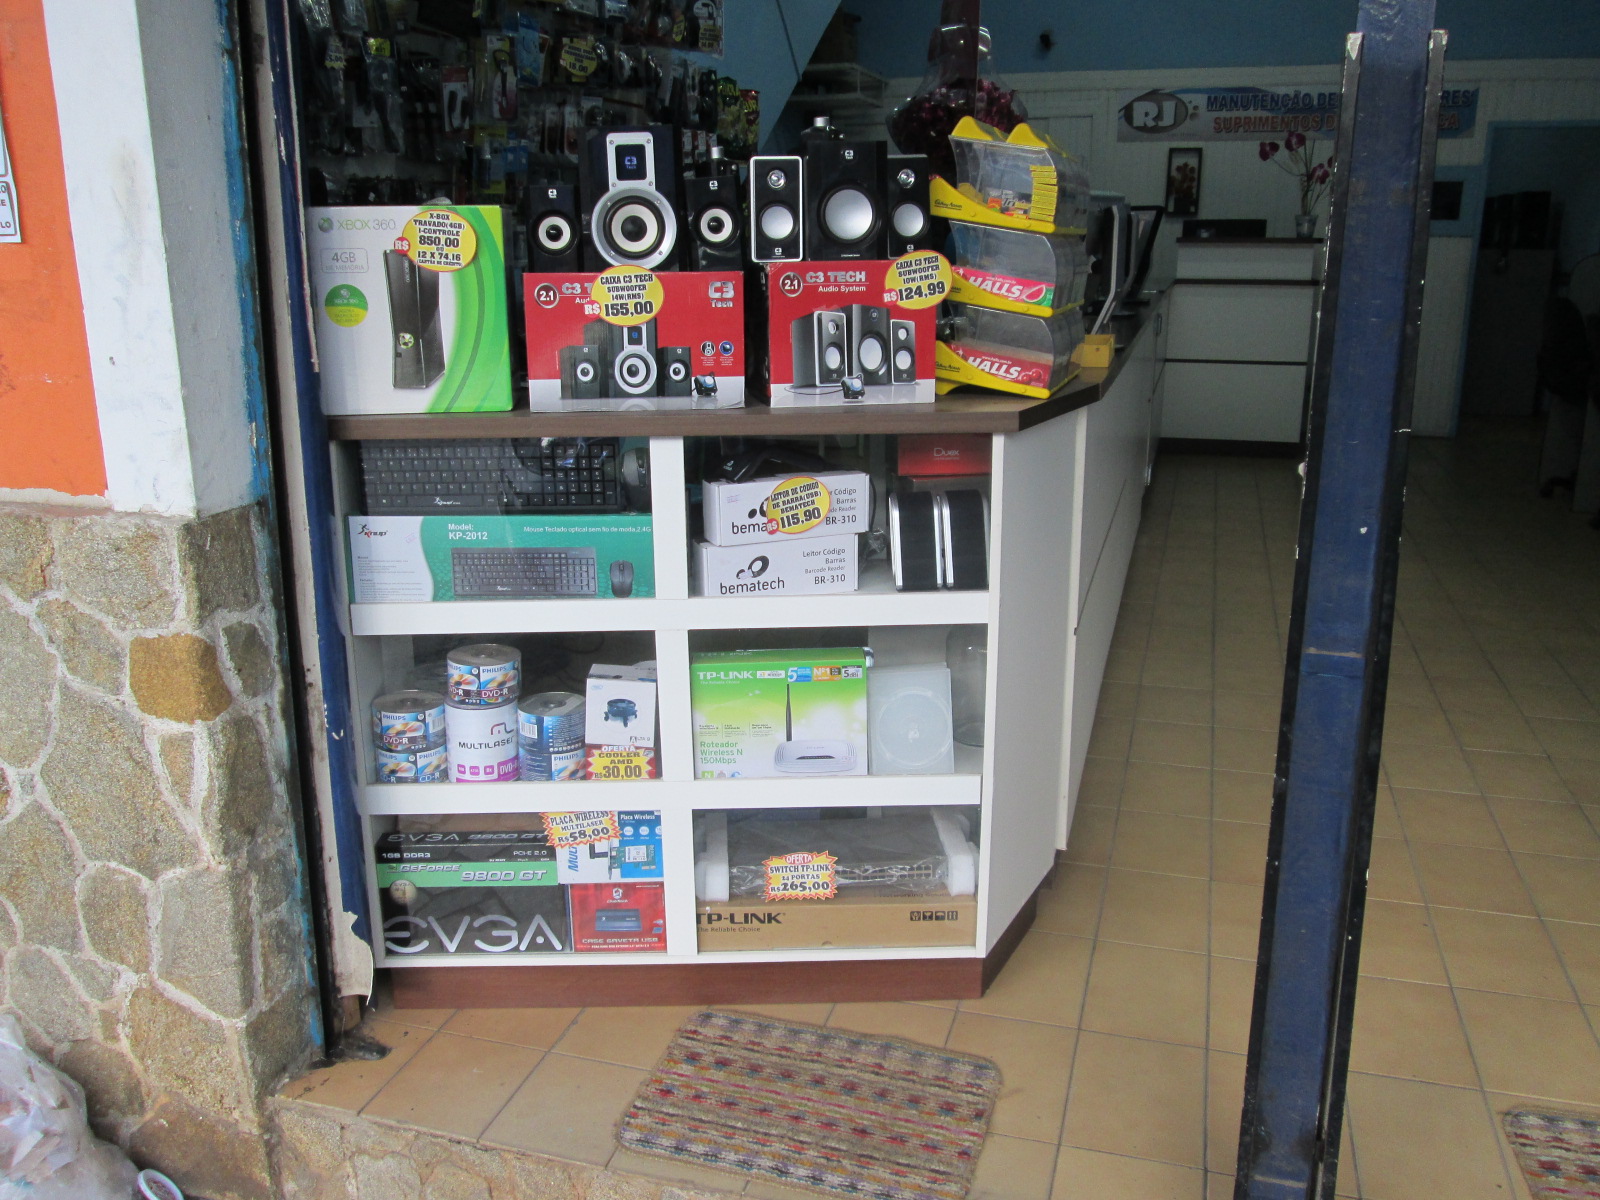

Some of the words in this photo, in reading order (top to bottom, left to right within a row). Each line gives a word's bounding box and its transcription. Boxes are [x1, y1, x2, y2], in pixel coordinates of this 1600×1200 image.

[1206, 91, 1315, 112] MANUTENÇÃO
[1132, 101, 1177, 127] RJ
[1213, 114, 1321, 133] SUPRIMENTOS
[337, 219, 371, 230] XBOX
[373, 219, 396, 230] 360
[332, 252, 356, 263] 4GB
[896, 261, 913, 270] CAIXA
[915, 258, 922, 266] C3
[924, 256, 939, 265] TECH
[898, 264, 940, 277] SUBWOOFER
[600, 276, 621, 285] CAIXA
[623, 275, 632, 283] C3
[634, 274, 653, 282] TECH
[806, 272, 824, 282] C3
[827, 271, 866, 282] TECH
[562, 283, 581, 294] C3
[607, 284, 647, 293] SUBWOOFER
[708, 282, 735, 298] C3
[784, 280, 798, 290] 2.1
[841, 285, 866, 293] System
[968, 276, 1023, 298] HALLS
[540, 290, 554, 301] 2.1
[883, 291, 897, 303] R$
[898, 281, 946, 302] 124,99
[584, 303, 600, 314] R$
[604, 301, 654, 317] 155,00
[967, 356, 1021, 379] HALLS
[770, 489, 790, 501] LEITOR
[791, 487, 798, 496] DE
[834, 488, 857, 496] Código
[780, 499, 816, 514] BEMATECH
[780, 507, 821, 529] 115,90
[825, 515, 857, 525] BR-310
[568, 526, 588, 534] optical
[449, 532, 488, 540] KP-2012
[803, 549, 821, 557] Leitor
[822, 548, 846, 556] Código
[825, 557, 846, 565] Barras
[815, 574, 846, 585] BR-310
[720, 577, 785, 595] bematech
[482, 665, 507, 674] PHILIPS
[697, 671, 753, 680] TP-LINK
[482, 689, 508, 698] DVD-R
[383, 736, 409, 744] DVD-R
[554, 752, 579, 761] PHILIPS
[700, 757, 737, 765] 150Mbps
[550, 813, 573, 826] PLACA
[574, 810, 609, 822] WIRELESS
[561, 820, 604, 832] MULTILASER
[786, 854, 812, 864] OFERTA
[770, 865, 799, 874] SWITCH
[801, 864, 830, 873] TP-LINK
[461, 870, 515, 881] 9800
[519, 870, 547, 881] GT
[697, 913, 783, 925] TP-LINK
[384, 914, 563, 953] EVGA
